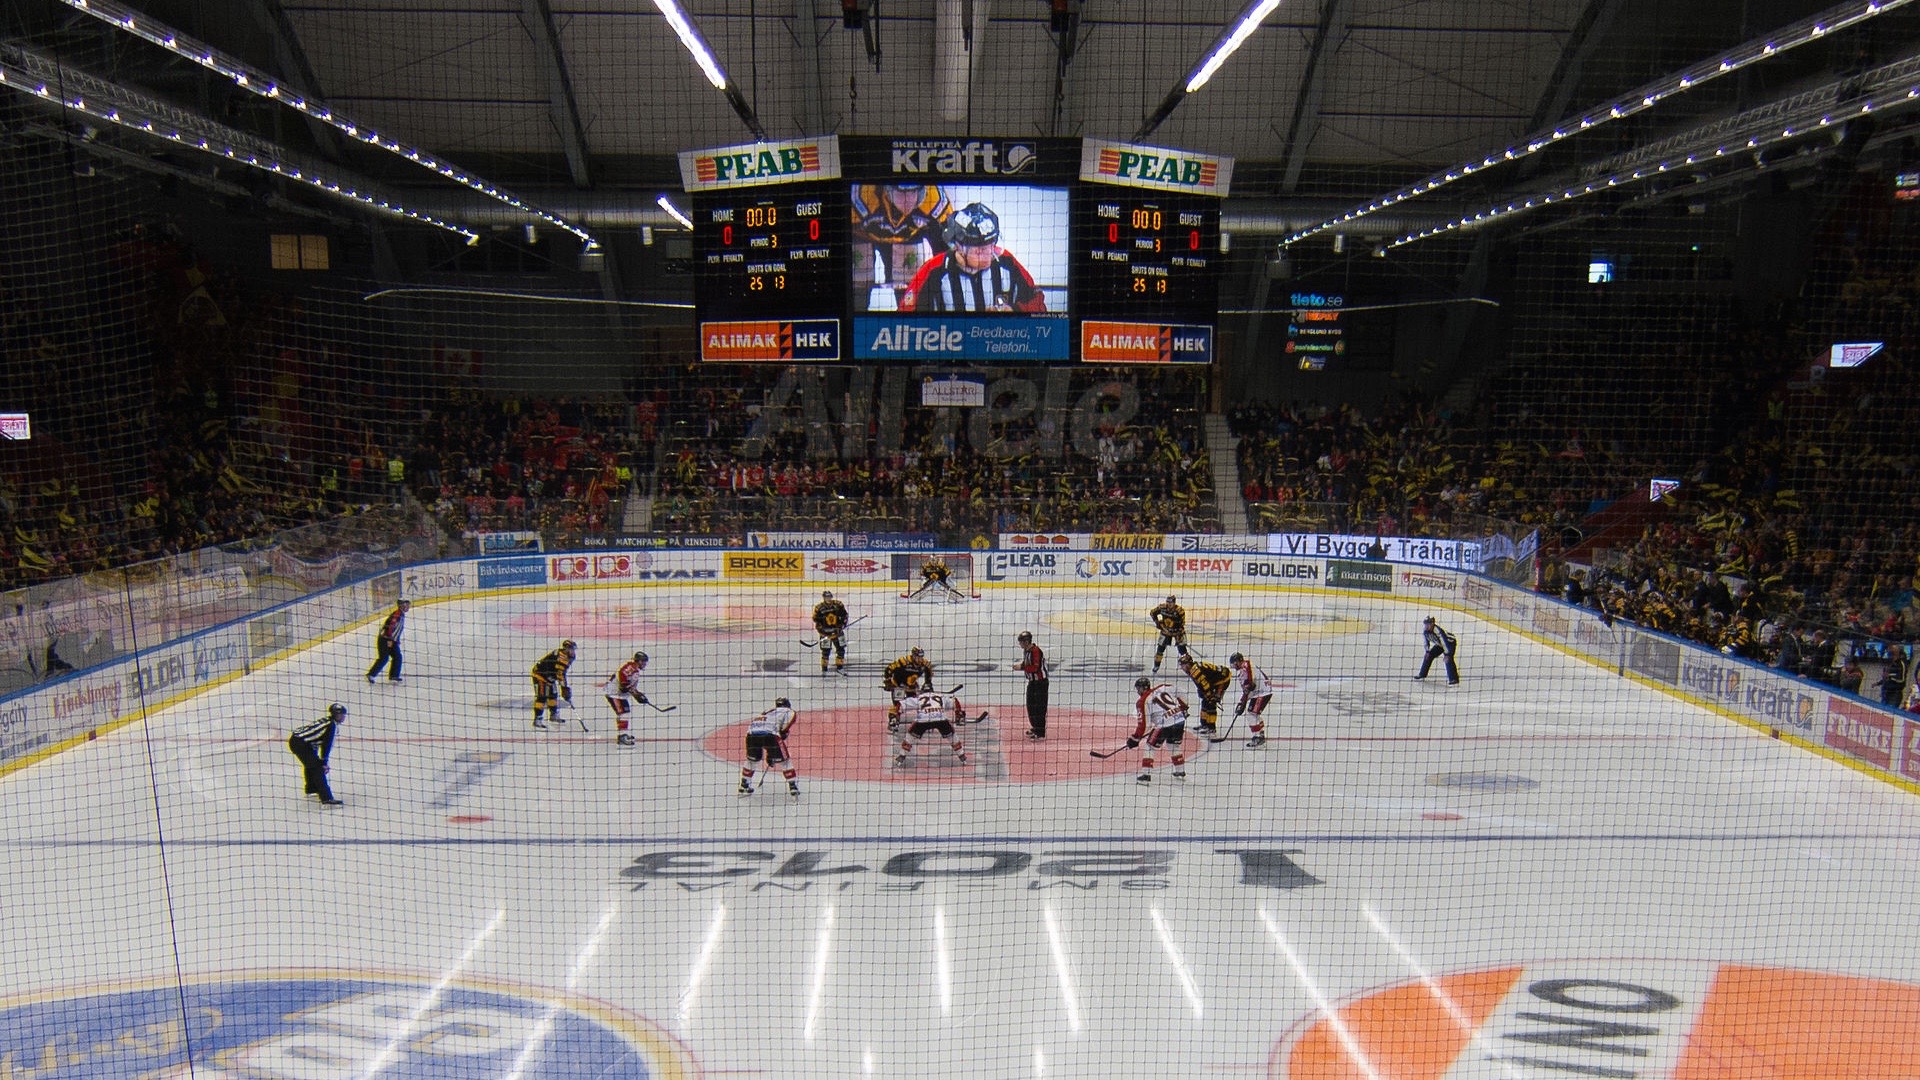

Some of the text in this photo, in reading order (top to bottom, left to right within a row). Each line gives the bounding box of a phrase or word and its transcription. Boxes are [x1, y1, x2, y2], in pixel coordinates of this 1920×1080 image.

[713, 147, 803, 181] PEAB
[892, 142, 998, 173] kraft
[1116, 151, 1202, 186] PEAB
[712, 209, 734, 222] HOME
[796, 202, 822, 216] GUEST
[1098, 205, 1119, 218] HOME
[1179, 213, 1202, 226] GUEST
[724, 226, 732, 245] 0
[810, 219, 819, 240] 0
[1109, 223, 1118, 243] 0
[771, 235, 777, 248] 3
[1135, 239, 1161, 252] PERIOD 3
[1190, 231, 1198, 250] 0
[723, 254, 744, 263] PENALTY
[807, 249, 830, 259] PENALTY
[1107, 252, 1128, 261] PENALTY
[750, 277, 763, 290] 25
[774, 276, 785, 289] 13
[1133, 278, 1145, 292] 25
[1157, 279, 1166, 293] 13
[872, 325, 963, 351] AllTele
[1036, 326, 1051, 338] TV
[708, 334, 776, 348] ALIMAK
[795, 332, 832, 347] HEK
[1090, 334, 1156, 350] ALIMAK
[1173, 338, 1205, 352] HEK
[669, 536, 680, 546] PÅ
[685, 537, 723, 546] RINKSIDE
[1287, 535, 1307, 554] Vi
[1316, 536, 1391, 558] Byggr
[730, 557, 799, 569] BROKK
[1010, 554, 1056, 567] LEAB
[1177, 559, 1232, 571] REPAY
[1102, 560, 1132, 577] SSC
[1247, 562, 1318, 579] BOLIDEN
[1681, 662, 1723, 697] kraft
[1745, 684, 1793, 725] kraft
[1827, 711, 1891, 754] FRANKE
[617, 850, 1177, 879] 2013
